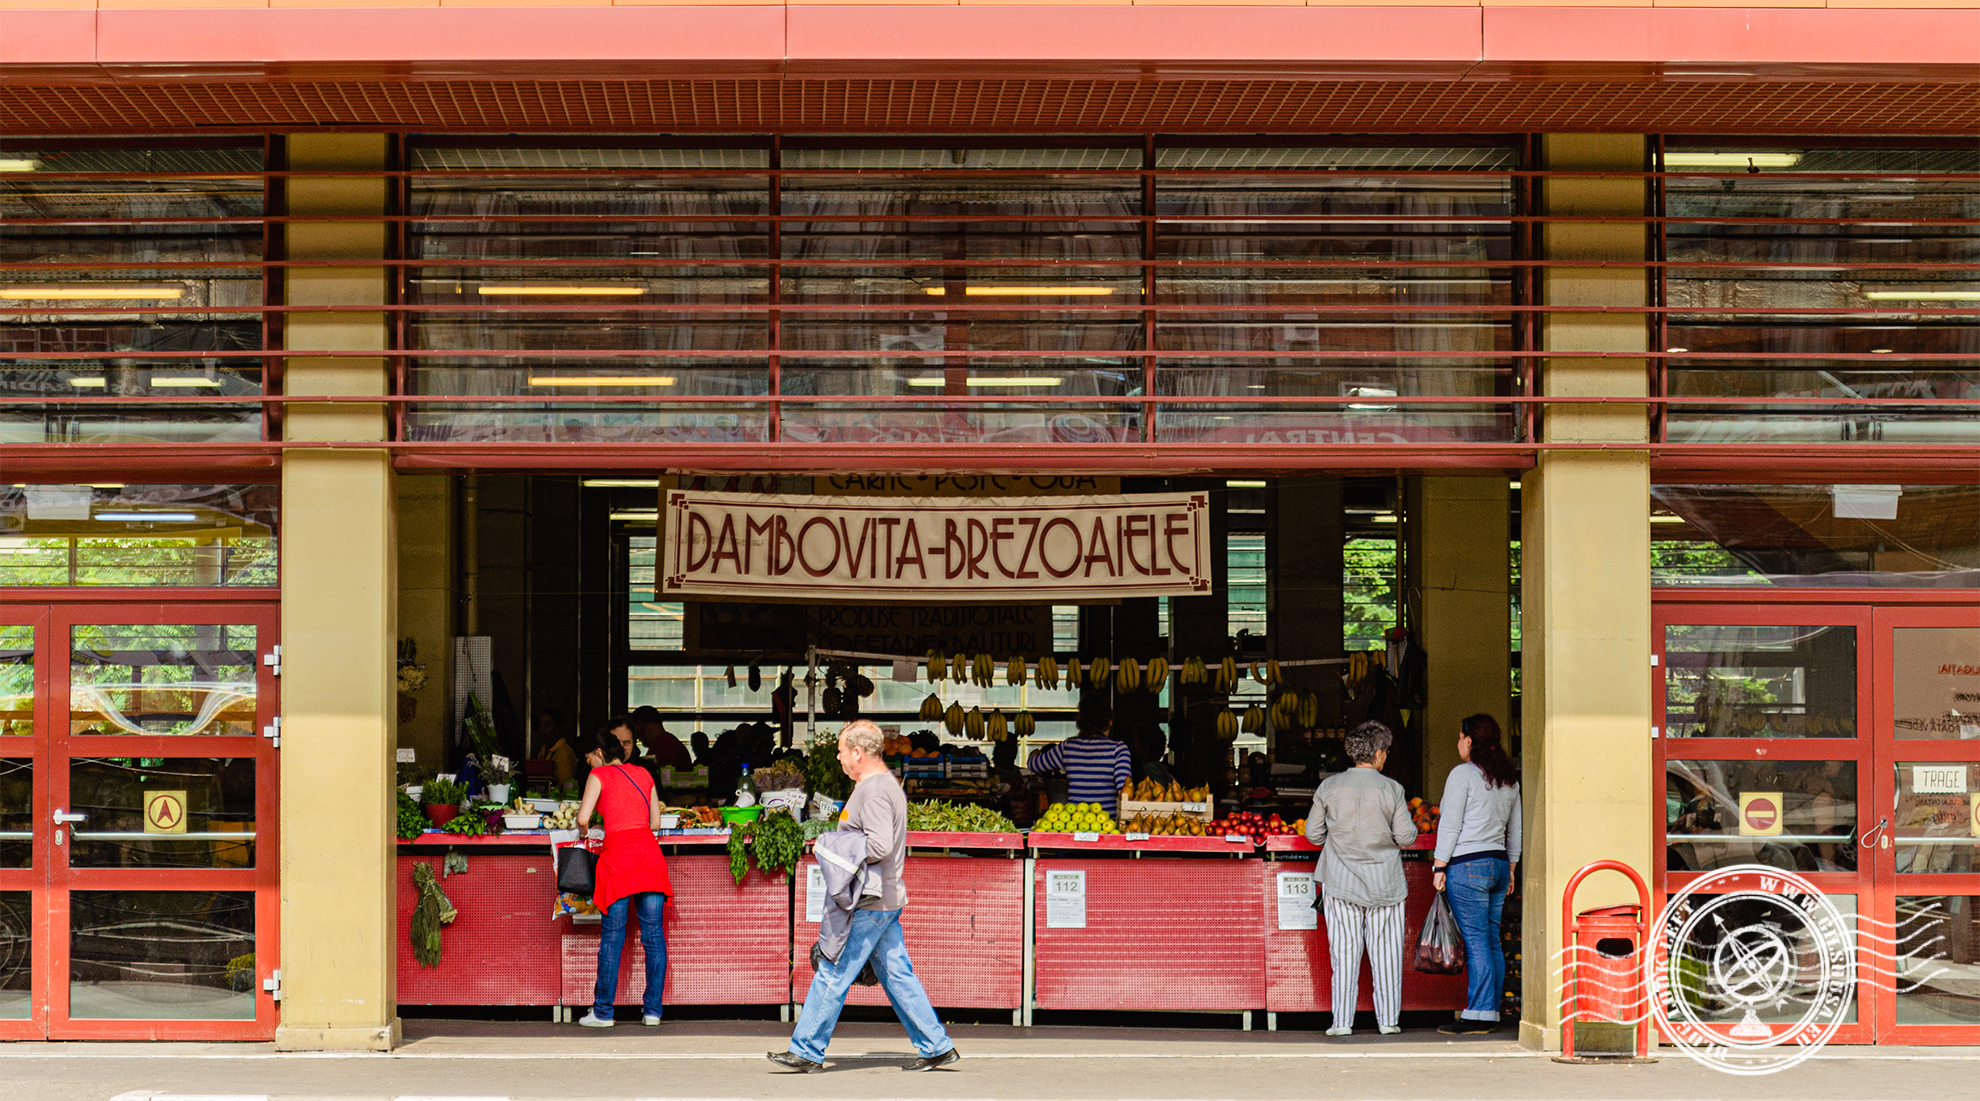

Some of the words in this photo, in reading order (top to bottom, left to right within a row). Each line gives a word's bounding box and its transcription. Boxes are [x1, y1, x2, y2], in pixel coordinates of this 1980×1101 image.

[686, 511, 1190, 580] DAMBOVITA-BREZOAIELE
[818, 606, 900, 629] PRODUSE
[908, 605, 1034, 628] TRADITIONALE
[818, 633, 935, 656] COFETARIE
[952, 631, 1036, 656] BAUTURI
[1923, 770, 1960, 788] TRAGE
[1056, 881, 1078, 892] 112
[1286, 883, 1309, 894] 113
